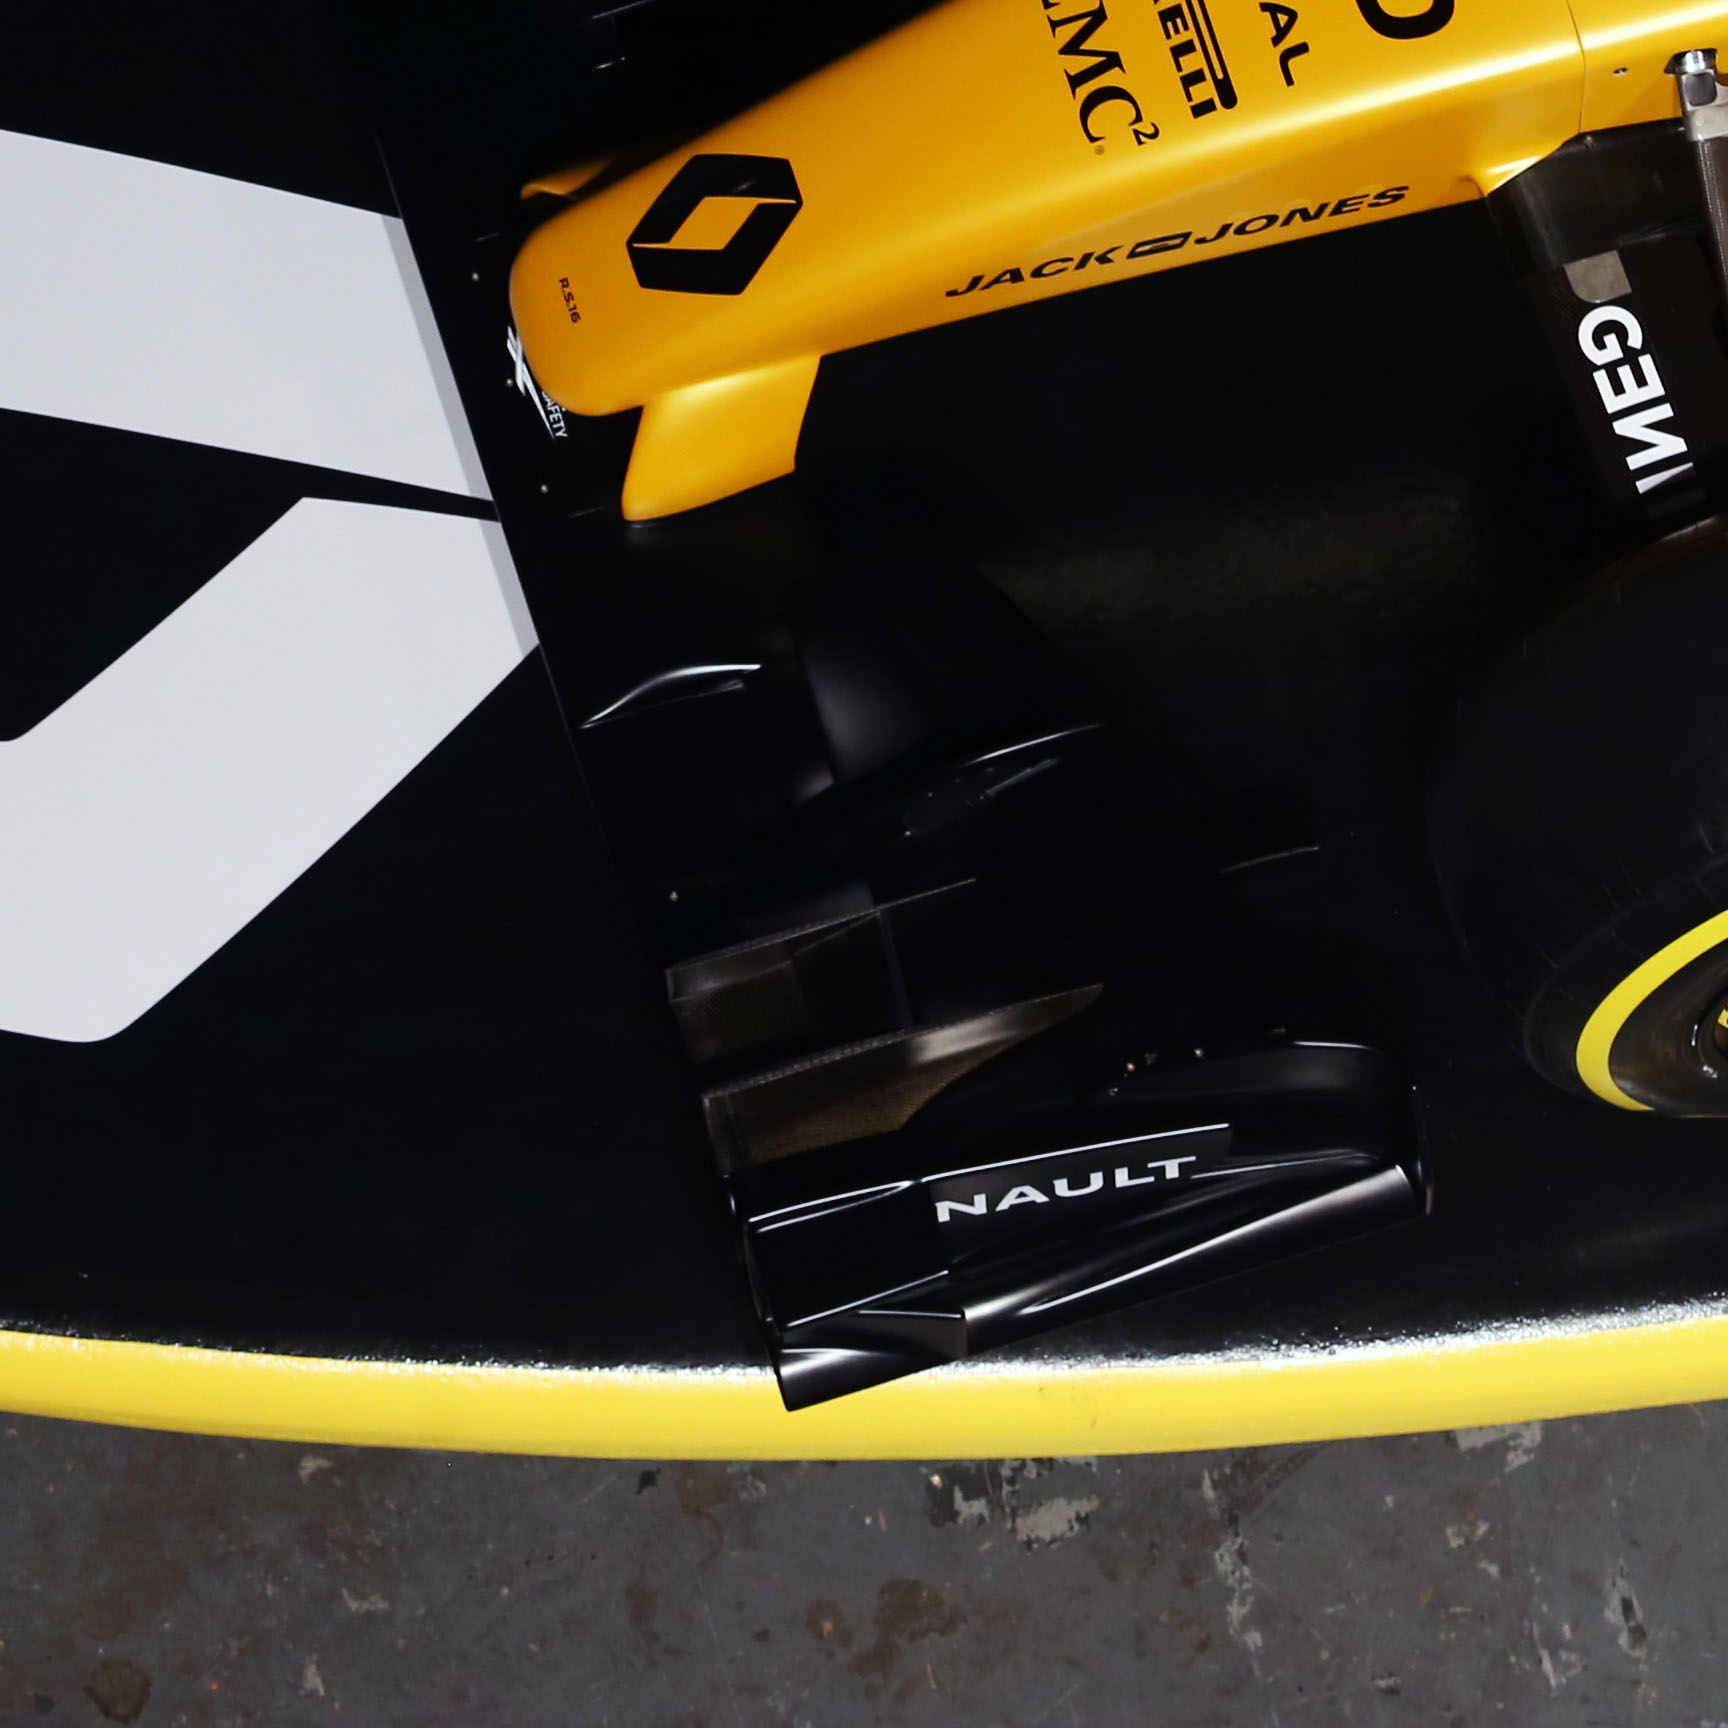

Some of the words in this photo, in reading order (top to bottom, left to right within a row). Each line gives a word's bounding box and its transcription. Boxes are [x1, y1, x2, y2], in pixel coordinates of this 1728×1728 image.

[945, 246, 1124, 299] JACK
[1193, 185, 1410, 246] JONES
[558, 277, 581, 324] R.S.16
[935, 1155, 1198, 1224] NAULT
